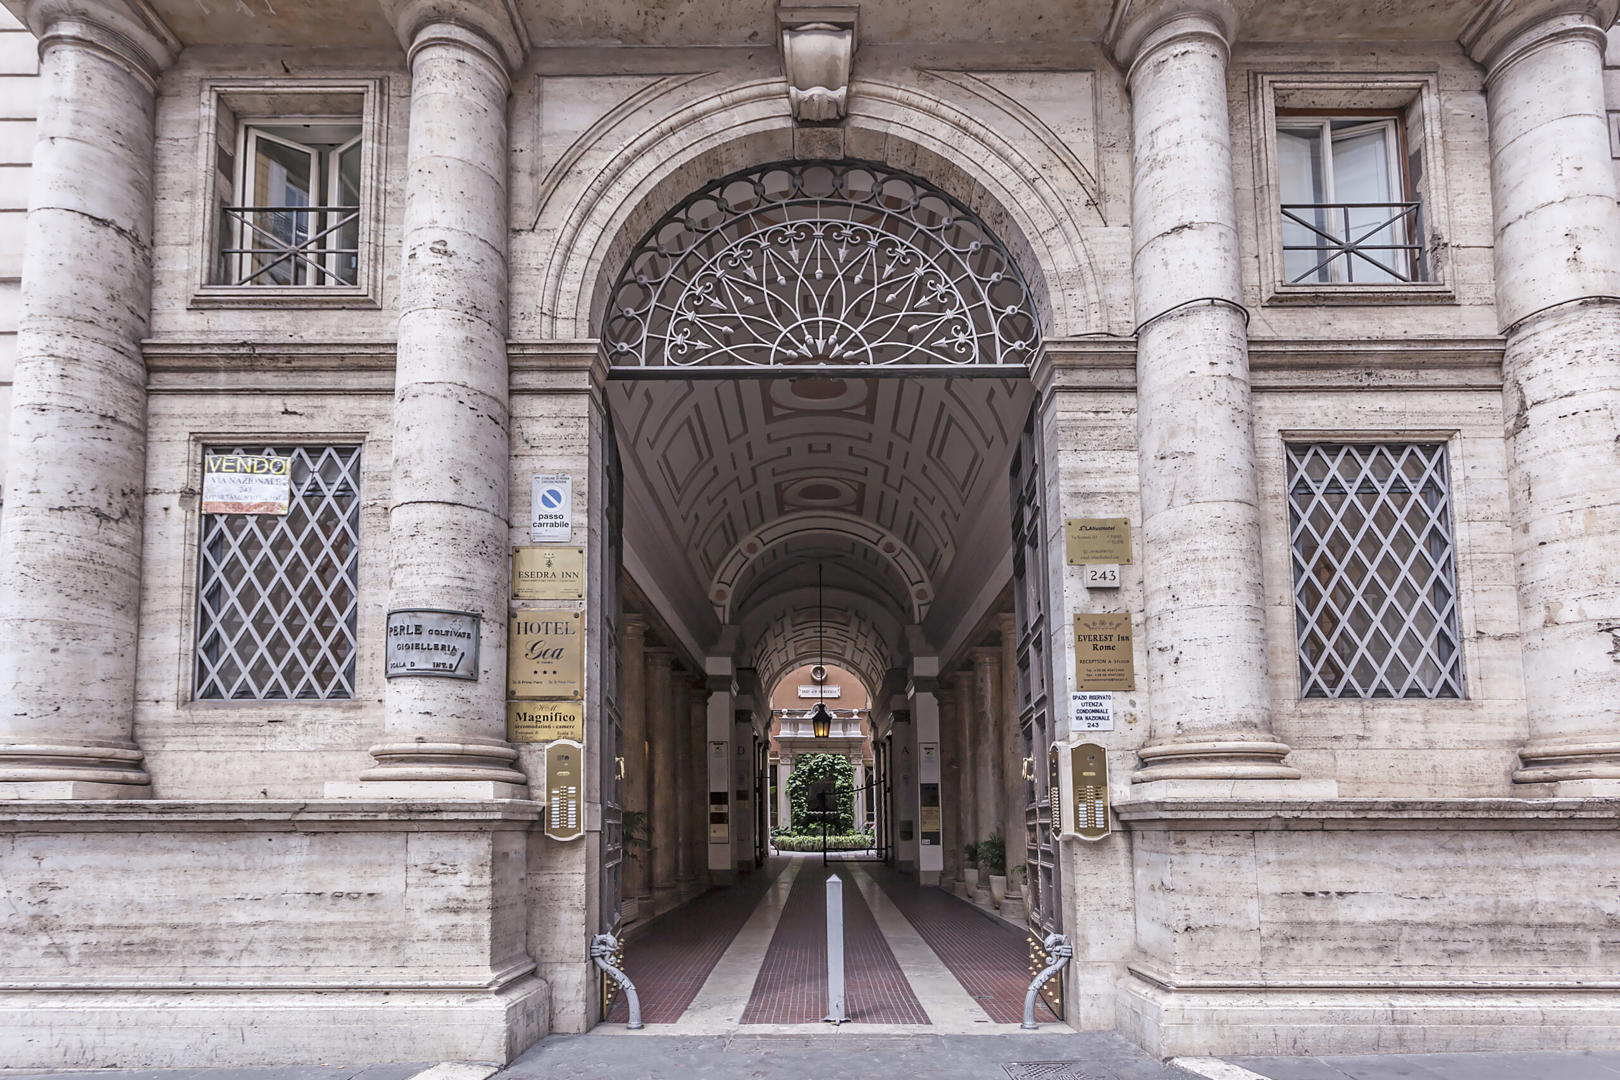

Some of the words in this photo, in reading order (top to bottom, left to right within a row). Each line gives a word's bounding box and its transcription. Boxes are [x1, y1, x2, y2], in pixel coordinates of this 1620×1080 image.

[207, 456, 286, 475] VENDO
[538, 513, 565, 521] passo
[532, 521, 570, 529] carrabile
[518, 571, 557, 579] ESEDRA
[561, 571, 580, 579] INN
[1090, 570, 1117, 581] 243
[389, 624, 423, 637] PERLE
[428, 628, 472, 639] COLTIVATE
[516, 621, 577, 636] HOTEL
[1077, 634, 1114, 642] EVEREST
[1118, 634, 1130, 642] Inn
[396, 642, 458, 653] GIOIELLERIA
[525, 640, 565, 660] Gea
[1092, 643, 1117, 652] Rome
[515, 712, 576, 724] Magnifico
